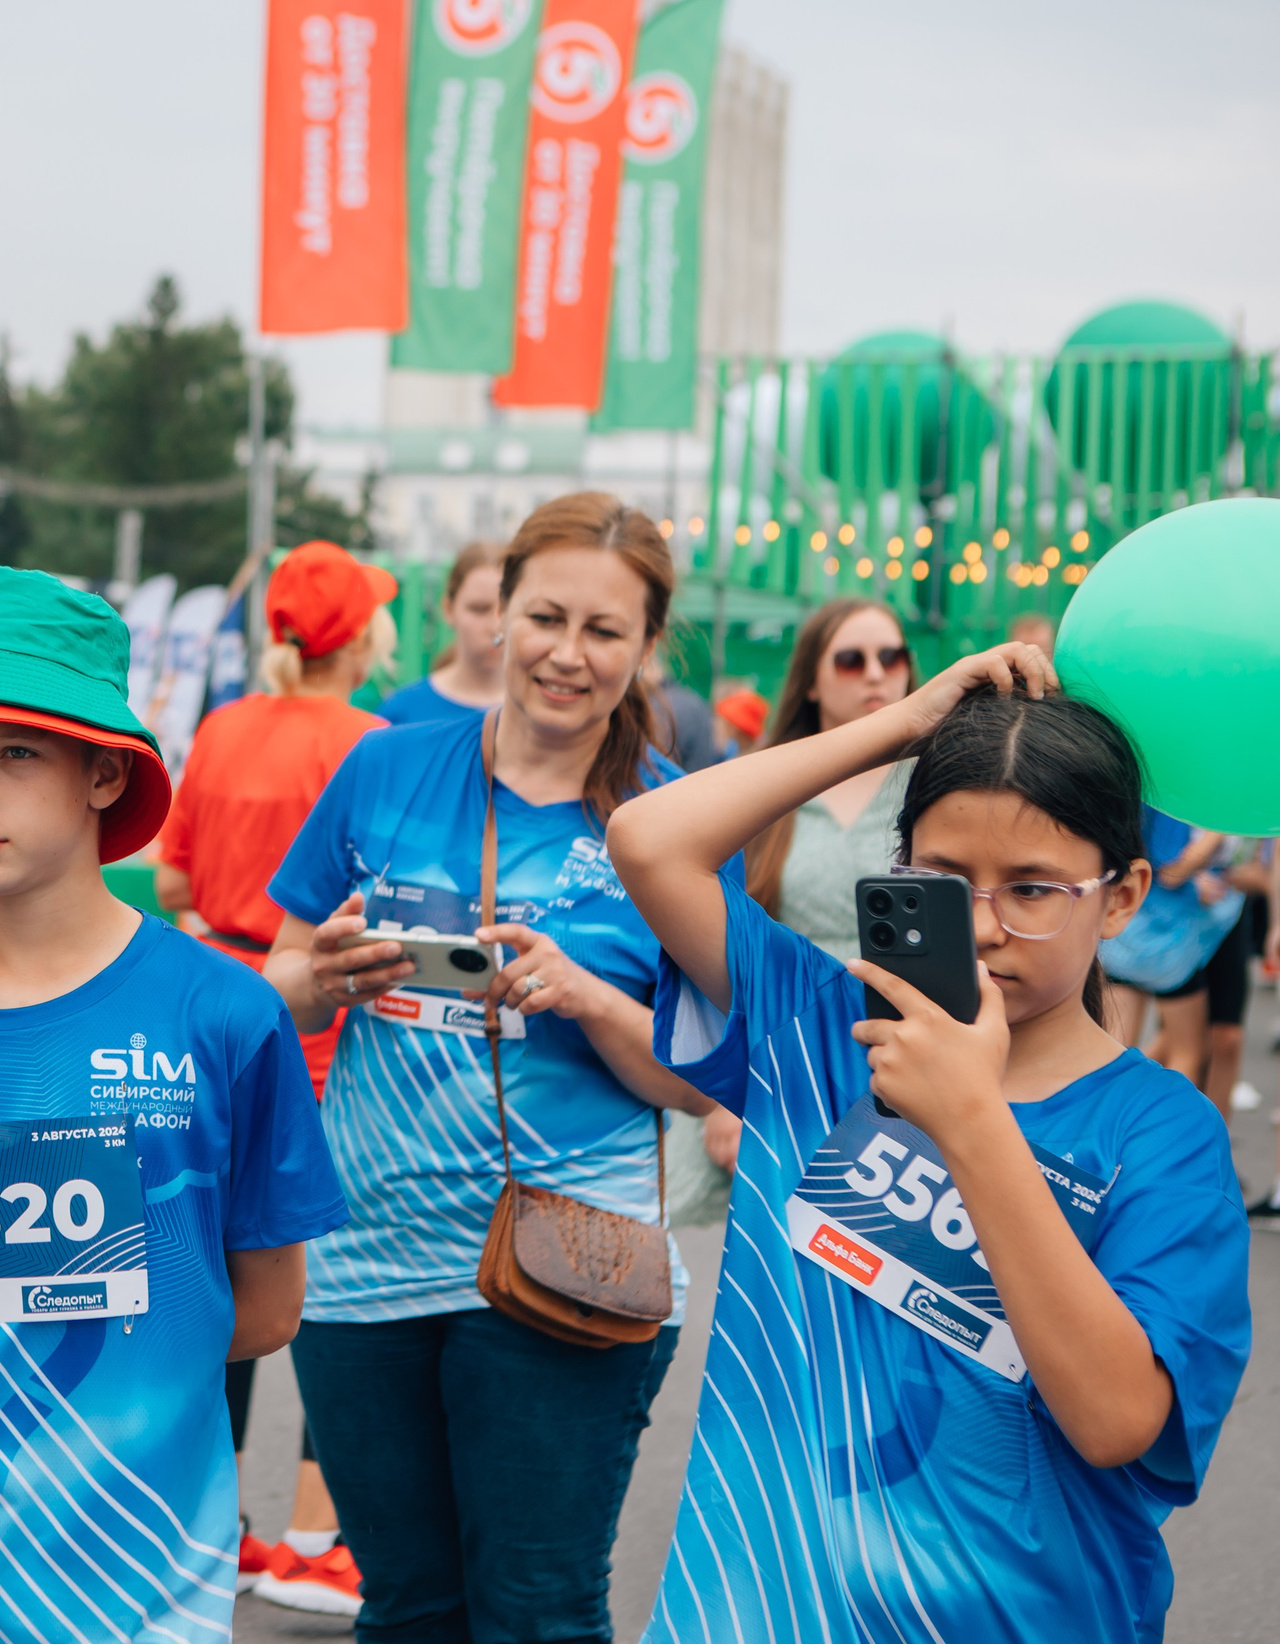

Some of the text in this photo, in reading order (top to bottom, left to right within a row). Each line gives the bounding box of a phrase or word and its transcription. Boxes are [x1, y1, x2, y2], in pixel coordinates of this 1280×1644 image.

[300, 14, 333, 66] от
[337, 12, 376, 209] Доставка
[534, 138, 562, 183] от
[293, 125, 332, 257] минут
[554, 139, 600, 305] Доставка
[522, 231, 553, 342] минут
[90, 1085, 195, 1102] СИБИРСКИЙ
[90, 1101, 193, 1114] МЕЖДУНАРОДНЫЙ
[31, 1126, 126, 1142] 3 АВГУСТА 2024
[90, 1112, 191, 1130] АФОН
[104, 1139, 126, 1148] 3 КМ
[843, 1131, 991, 1273] 556
[1071, 1182, 1102, 1204] 2024
[1071, 1197, 1080, 1206] 3
[817, 1232, 876, 1277] Альфа Банк
[36, 1293, 103, 1308] Следопыт
[916, 1297, 983, 1344] Следопыт
